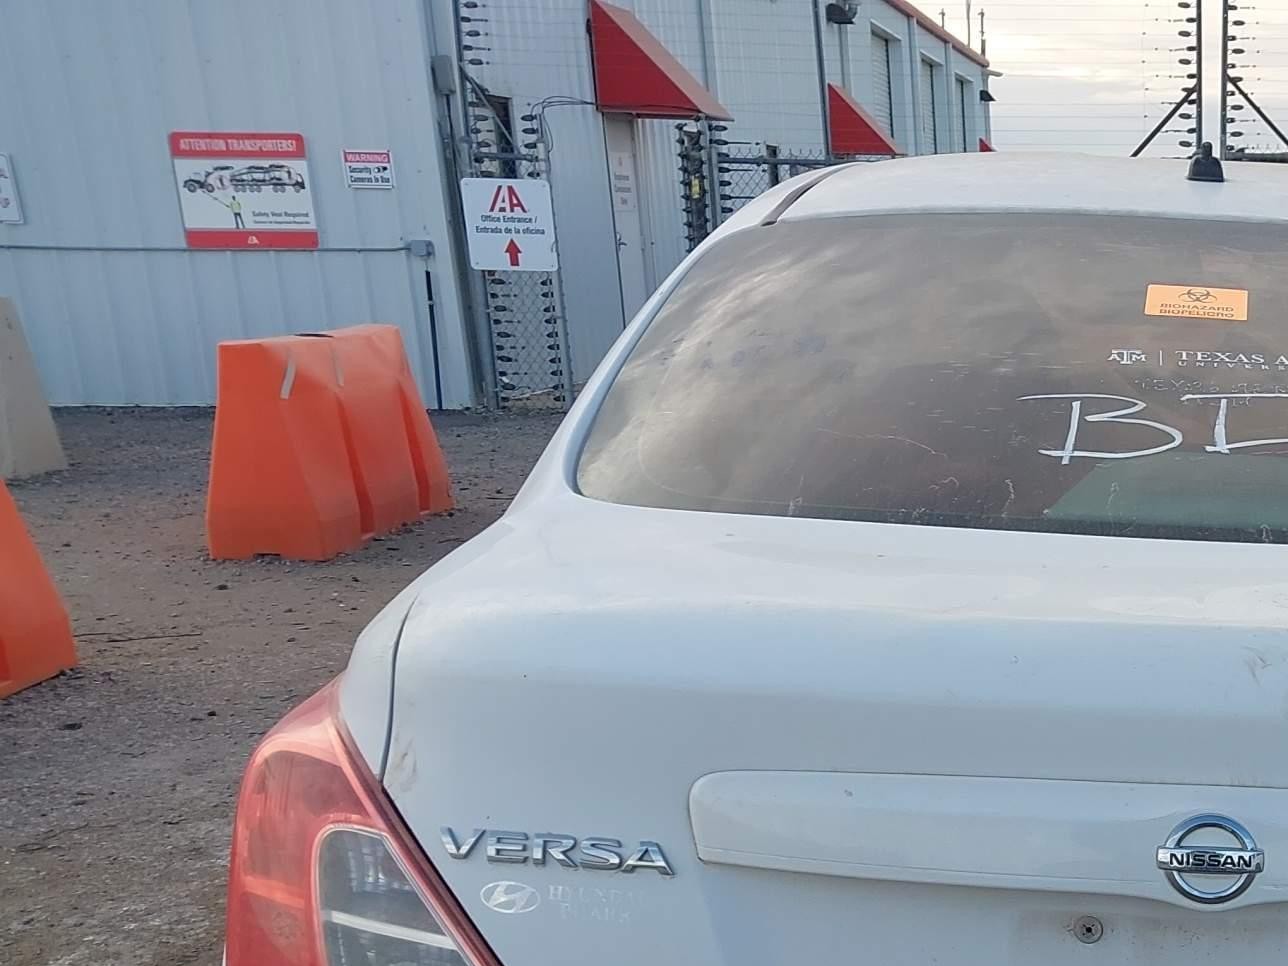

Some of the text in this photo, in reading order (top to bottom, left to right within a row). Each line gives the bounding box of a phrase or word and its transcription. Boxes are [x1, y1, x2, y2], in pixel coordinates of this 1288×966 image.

[179, 138, 296, 152] ATTENTION TRANSPORTERS!
[346, 153, 388, 162] WARNING
[349, 166, 371, 175] Security
[480, 214, 501, 223] Office
[502, 215, 533, 224] Entrance
[475, 225, 545, 235] Entrada de la oficina
[1159, 303, 1235, 312] BIOHAZARD
[1159, 309, 1235, 318] BIOPELIGRO
[1175, 350, 1265, 364] TEXAS
[440, 827, 676, 877] VERSA
[1168, 852, 1252, 869] NISSAN
